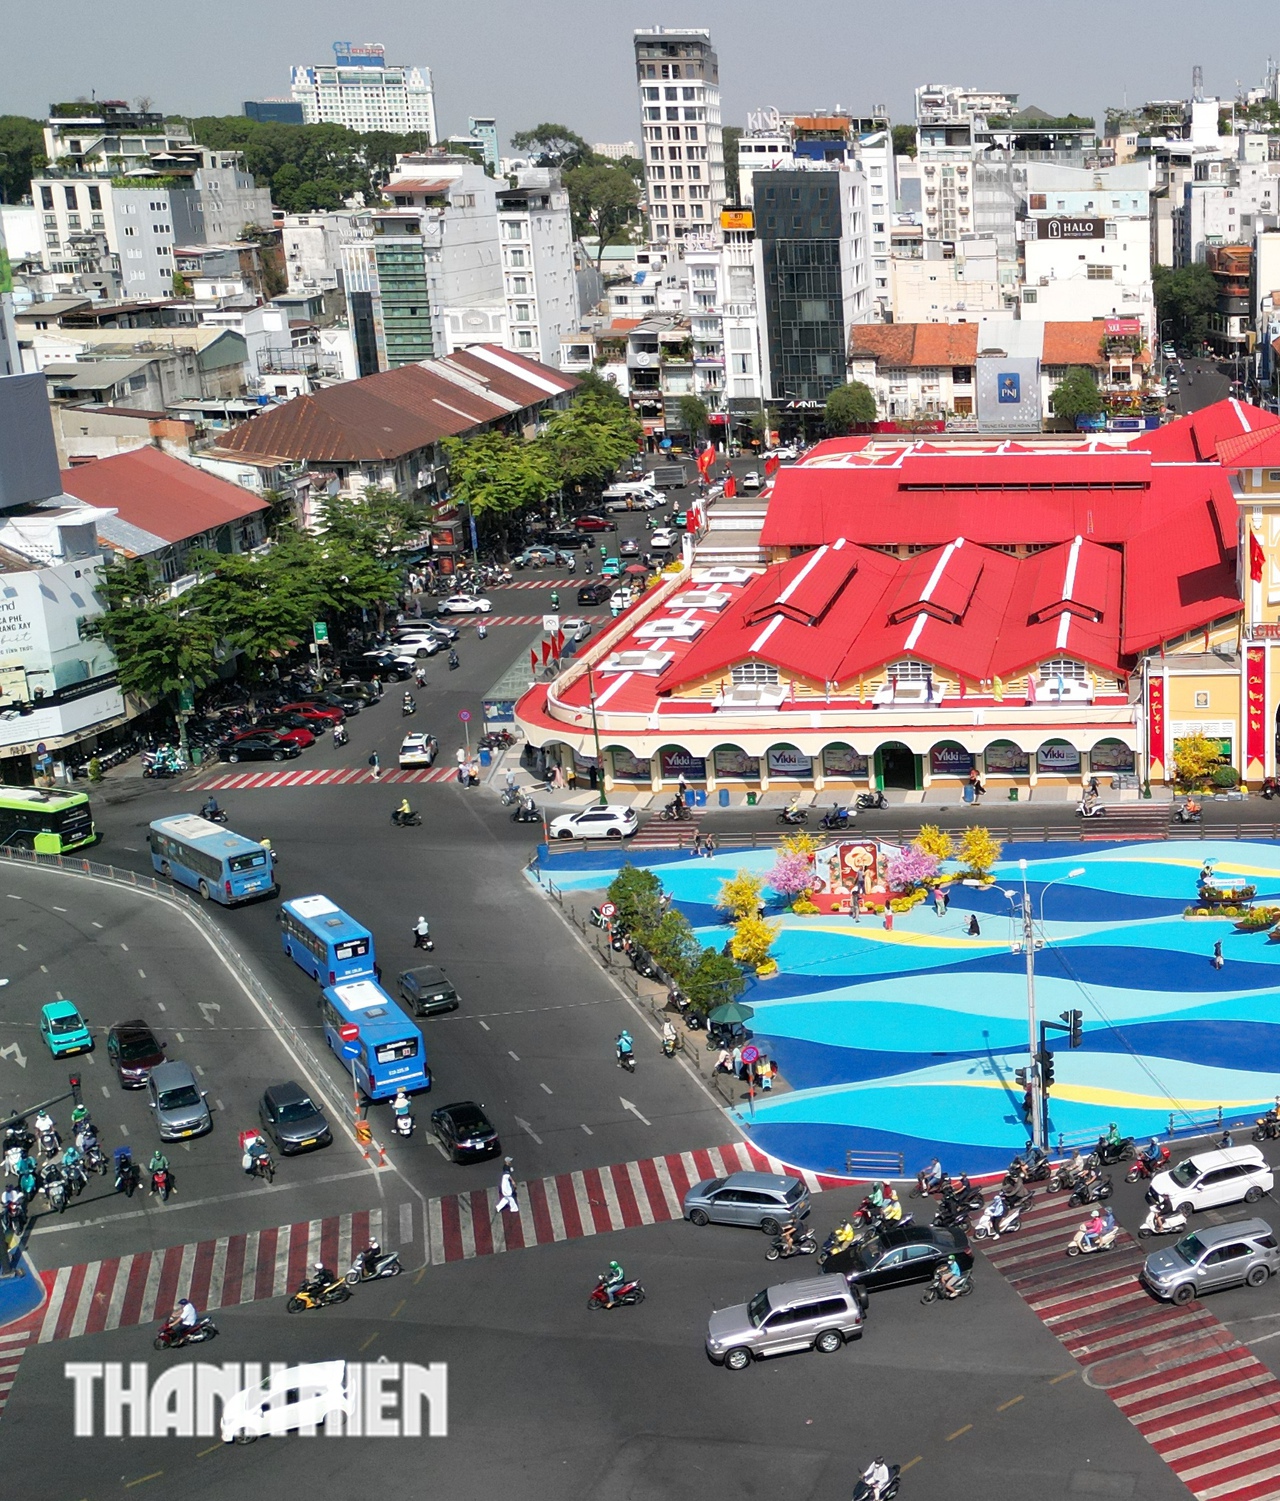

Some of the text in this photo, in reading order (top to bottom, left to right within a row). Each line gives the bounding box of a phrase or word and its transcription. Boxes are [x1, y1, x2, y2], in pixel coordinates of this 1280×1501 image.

[1063, 222, 1094, 232] HALO
[1001, 388, 1017, 398] PNJ
[19, 622, 31, 630] XAY
[665, 752, 690, 765] Vikki
[772, 751, 797, 763] Vikki
[934, 747, 959, 761] Vikki
[1041, 746, 1065, 759] Vikki
